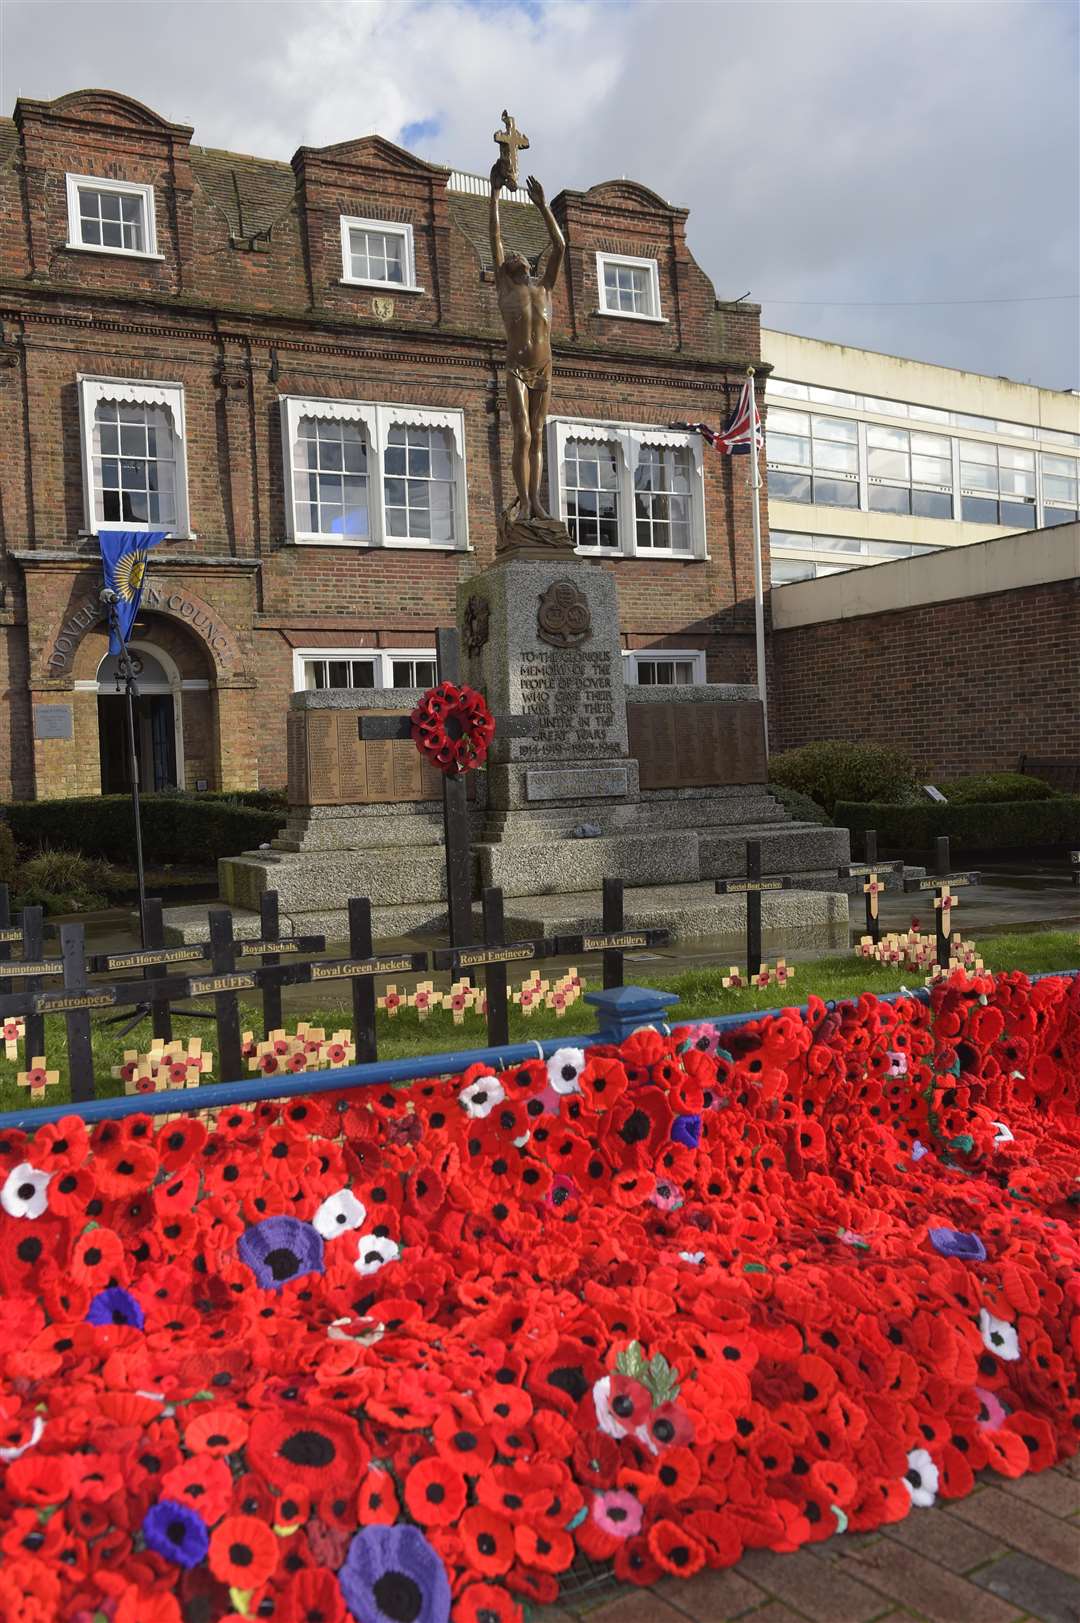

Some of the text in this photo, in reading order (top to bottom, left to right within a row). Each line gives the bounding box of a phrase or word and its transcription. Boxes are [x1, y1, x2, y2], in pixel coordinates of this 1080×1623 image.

[49, 603, 101, 667] DOVER
[593, 664, 611, 676] THE
[519, 678, 556, 690] PEOPLE
[575, 677, 612, 689] DOVER
[521, 692, 549, 704] WHO
[584, 690, 613, 702] THEIR
[555, 704, 577, 715] FOR
[584, 703, 615, 715] THEIR
[539, 716, 573, 728] UNTRY
[1, 931, 22, 941] Light
[584, 938, 608, 949] Royal
[243, 946, 266, 954] Royal
[109, 955, 134, 968] Royal
[136, 952, 161, 965] Horse
[460, 951, 486, 966] Royal
[312, 965, 341, 978] Royal
[342, 963, 373, 975] Green
[192, 982, 211, 992] The
